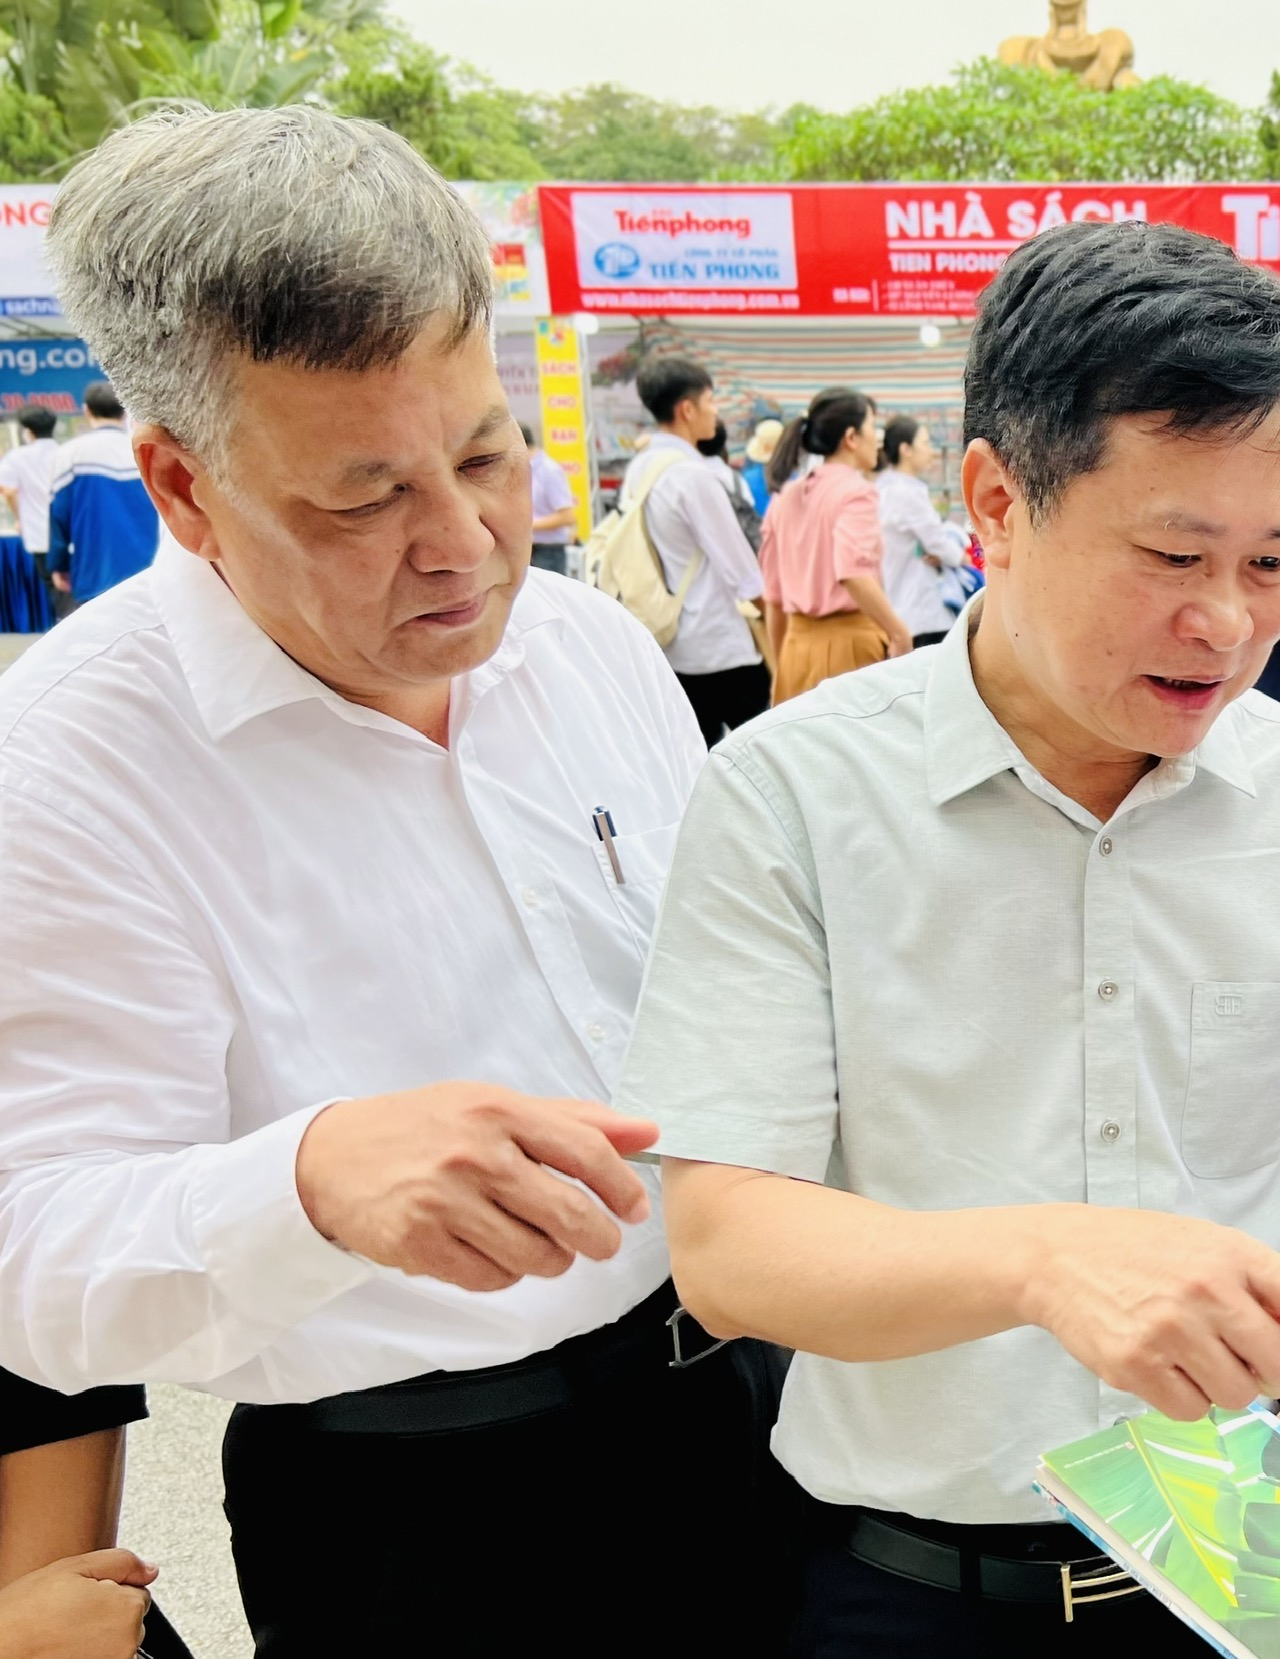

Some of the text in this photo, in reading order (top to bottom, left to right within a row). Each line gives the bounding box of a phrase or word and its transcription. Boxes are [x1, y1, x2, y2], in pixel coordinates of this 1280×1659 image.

[0, 200, 52, 227] NG
[885, 190, 995, 239] NHÀ
[705, 262, 780, 279] PHONG
